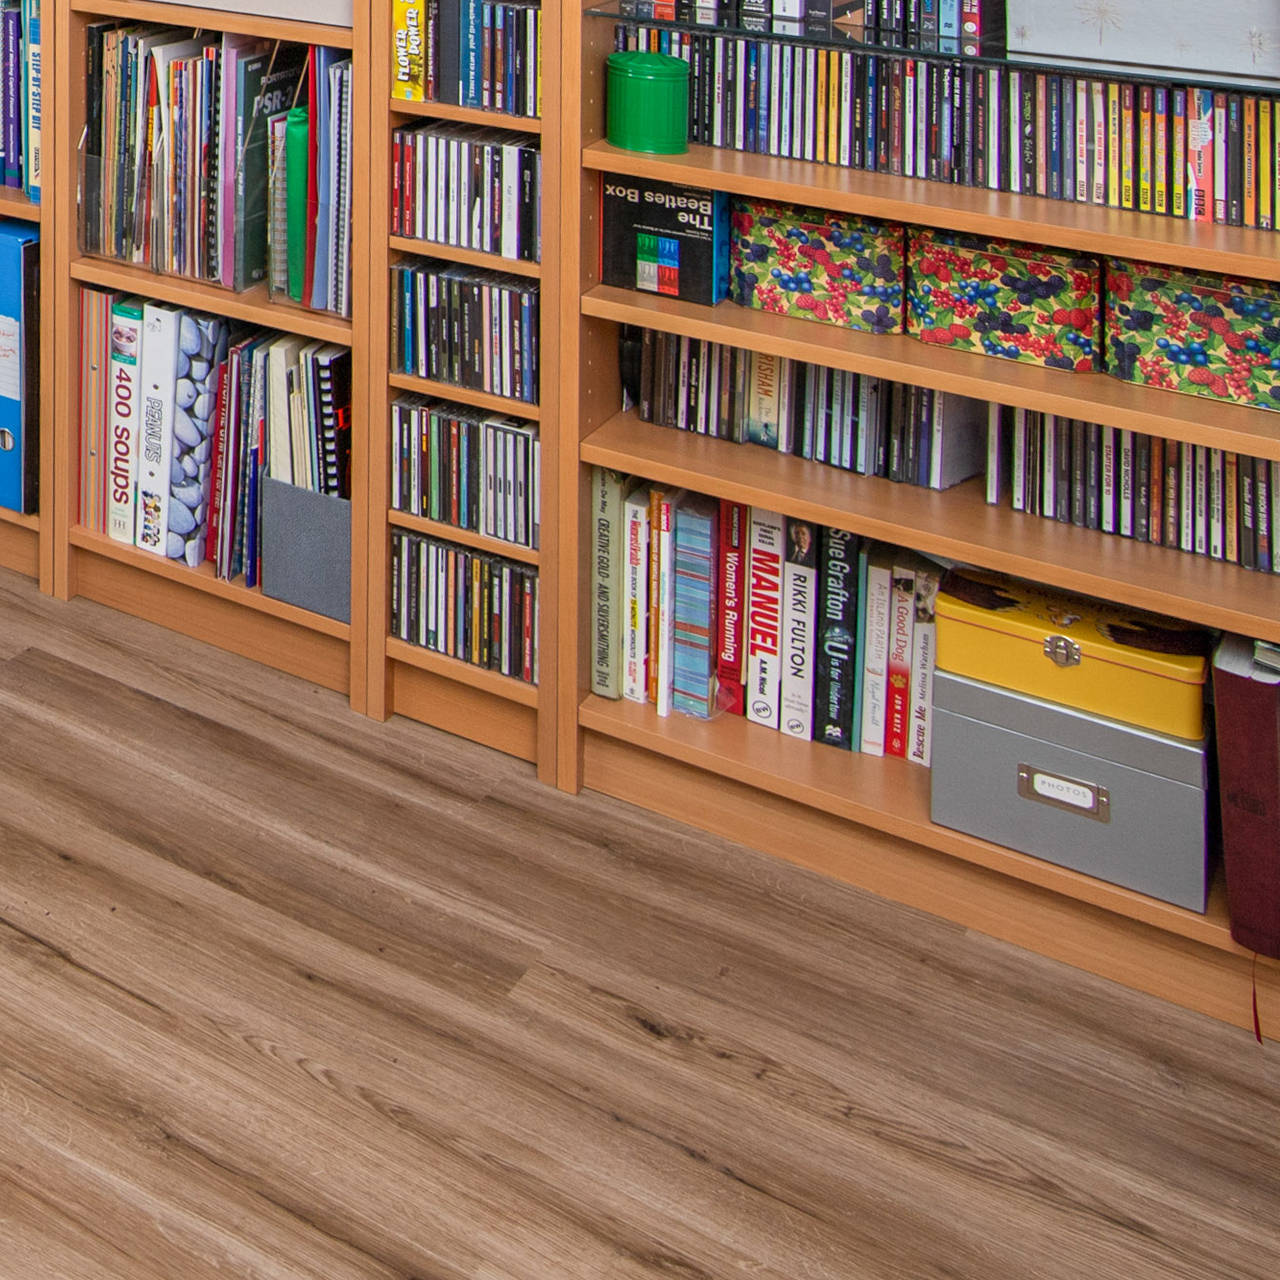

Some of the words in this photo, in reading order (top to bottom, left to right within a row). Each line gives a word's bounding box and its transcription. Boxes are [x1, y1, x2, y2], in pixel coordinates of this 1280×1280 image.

[605, 184, 639, 202] Box
[644, 192, 712, 215] Beatles
[677, 210, 713, 231] The
[114, 367, 132, 418] 400
[145, 395, 163, 465] PEANUTS
[111, 424, 131, 504] soups
[597, 518, 610, 555] CREATIVE
[828, 529, 851, 559] Sue
[597, 584, 609, 601] AND
[724, 552, 738, 607] Women's
[791, 572, 807, 613] RIKKI
[826, 560, 850, 620] Grafton
[749, 548, 779, 657] MANUEL
[897, 594, 910, 603] A
[596, 602, 609, 667] SILVERSMITHING
[895, 605, 909, 636] Good
[722, 611, 738, 662] Running
[790, 620, 807, 678] FULTON
[824, 641, 848, 659] U
[893, 638, 908, 662] Dog
[759, 659, 769, 674] A.M.
[830, 666, 842, 678] for
[758, 676, 768, 696] Nicol
[828, 681, 841, 718] Undertow
[915, 705, 926, 722] Me
[912, 724, 925, 760] Rescue
[1040, 779, 1088, 800] PHOTOS
